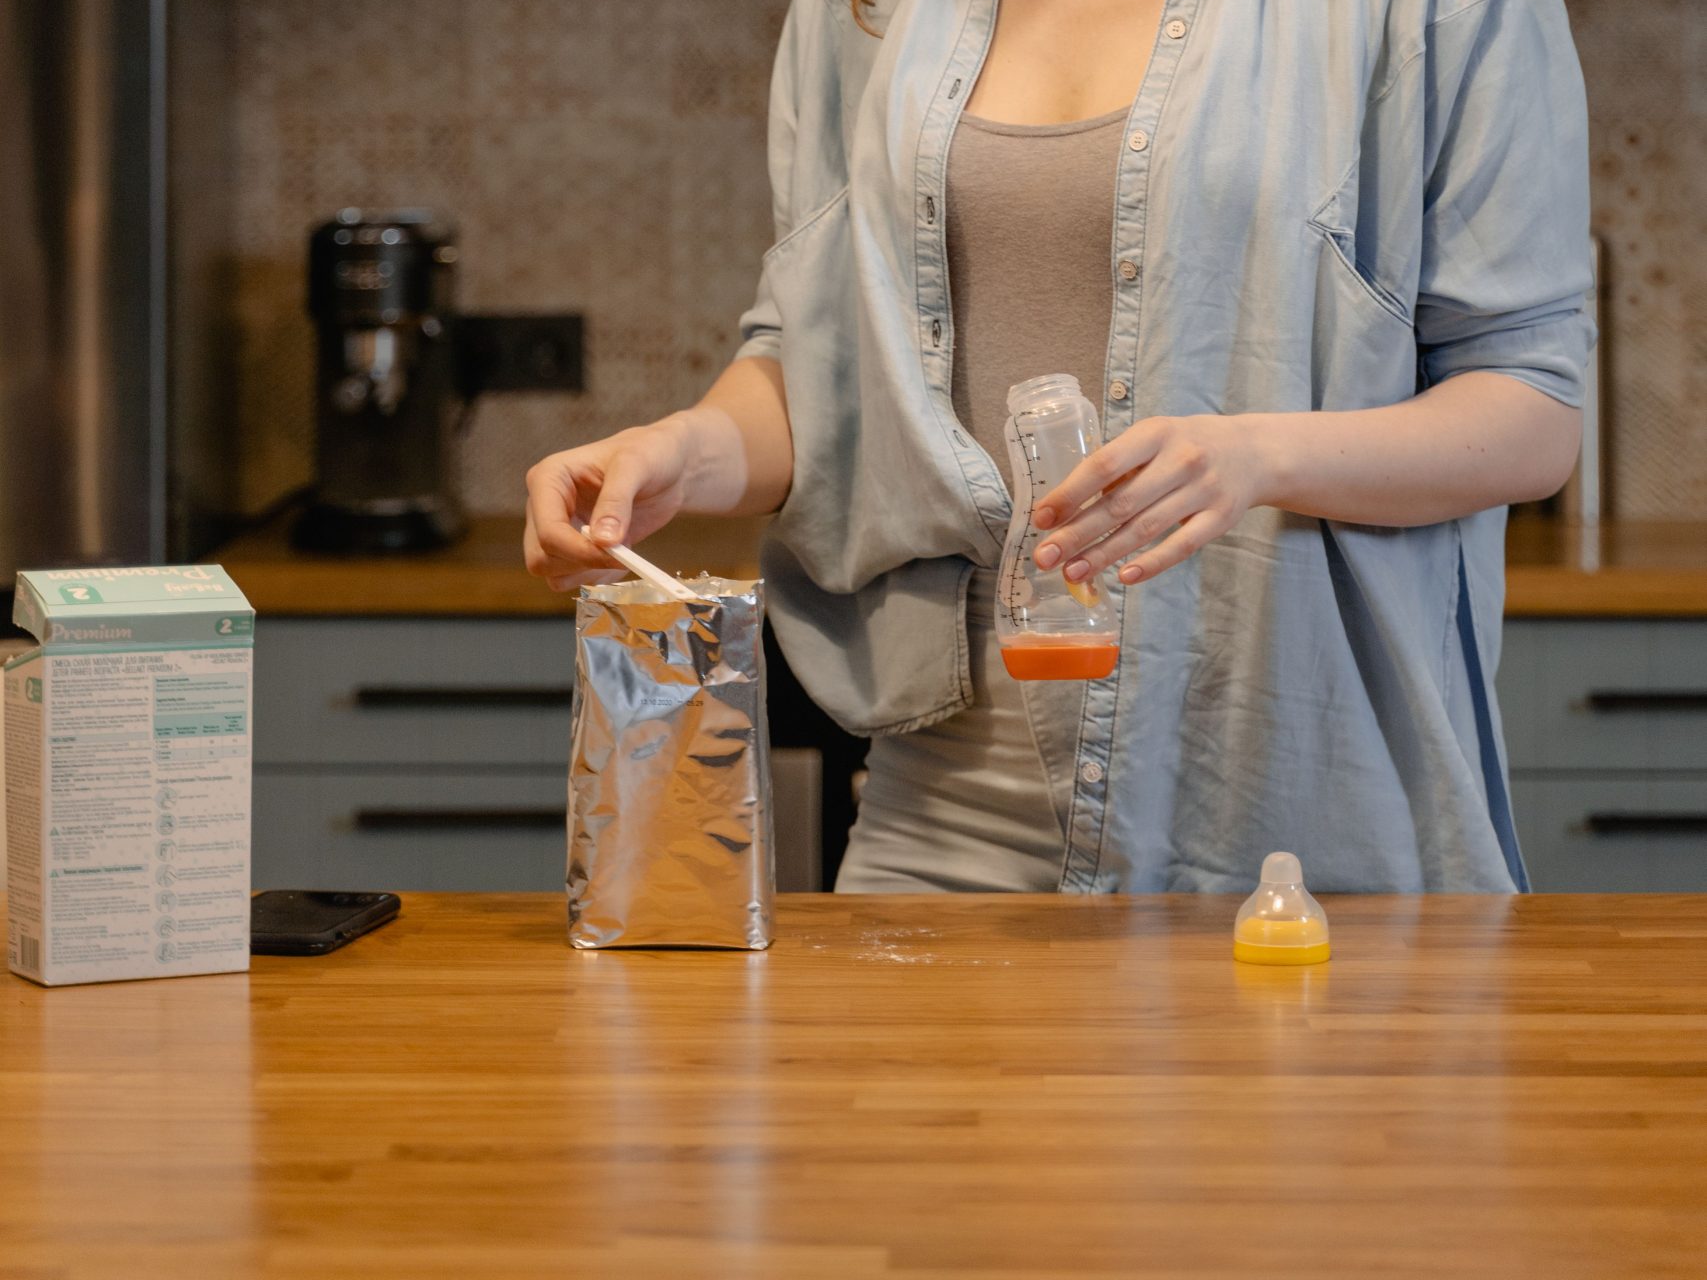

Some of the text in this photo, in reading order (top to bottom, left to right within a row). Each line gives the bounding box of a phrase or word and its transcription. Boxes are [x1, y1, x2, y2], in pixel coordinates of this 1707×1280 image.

[66, 586, 91, 600] 2
[51, 624, 133, 642] Premium
[219, 618, 232, 634] 2
